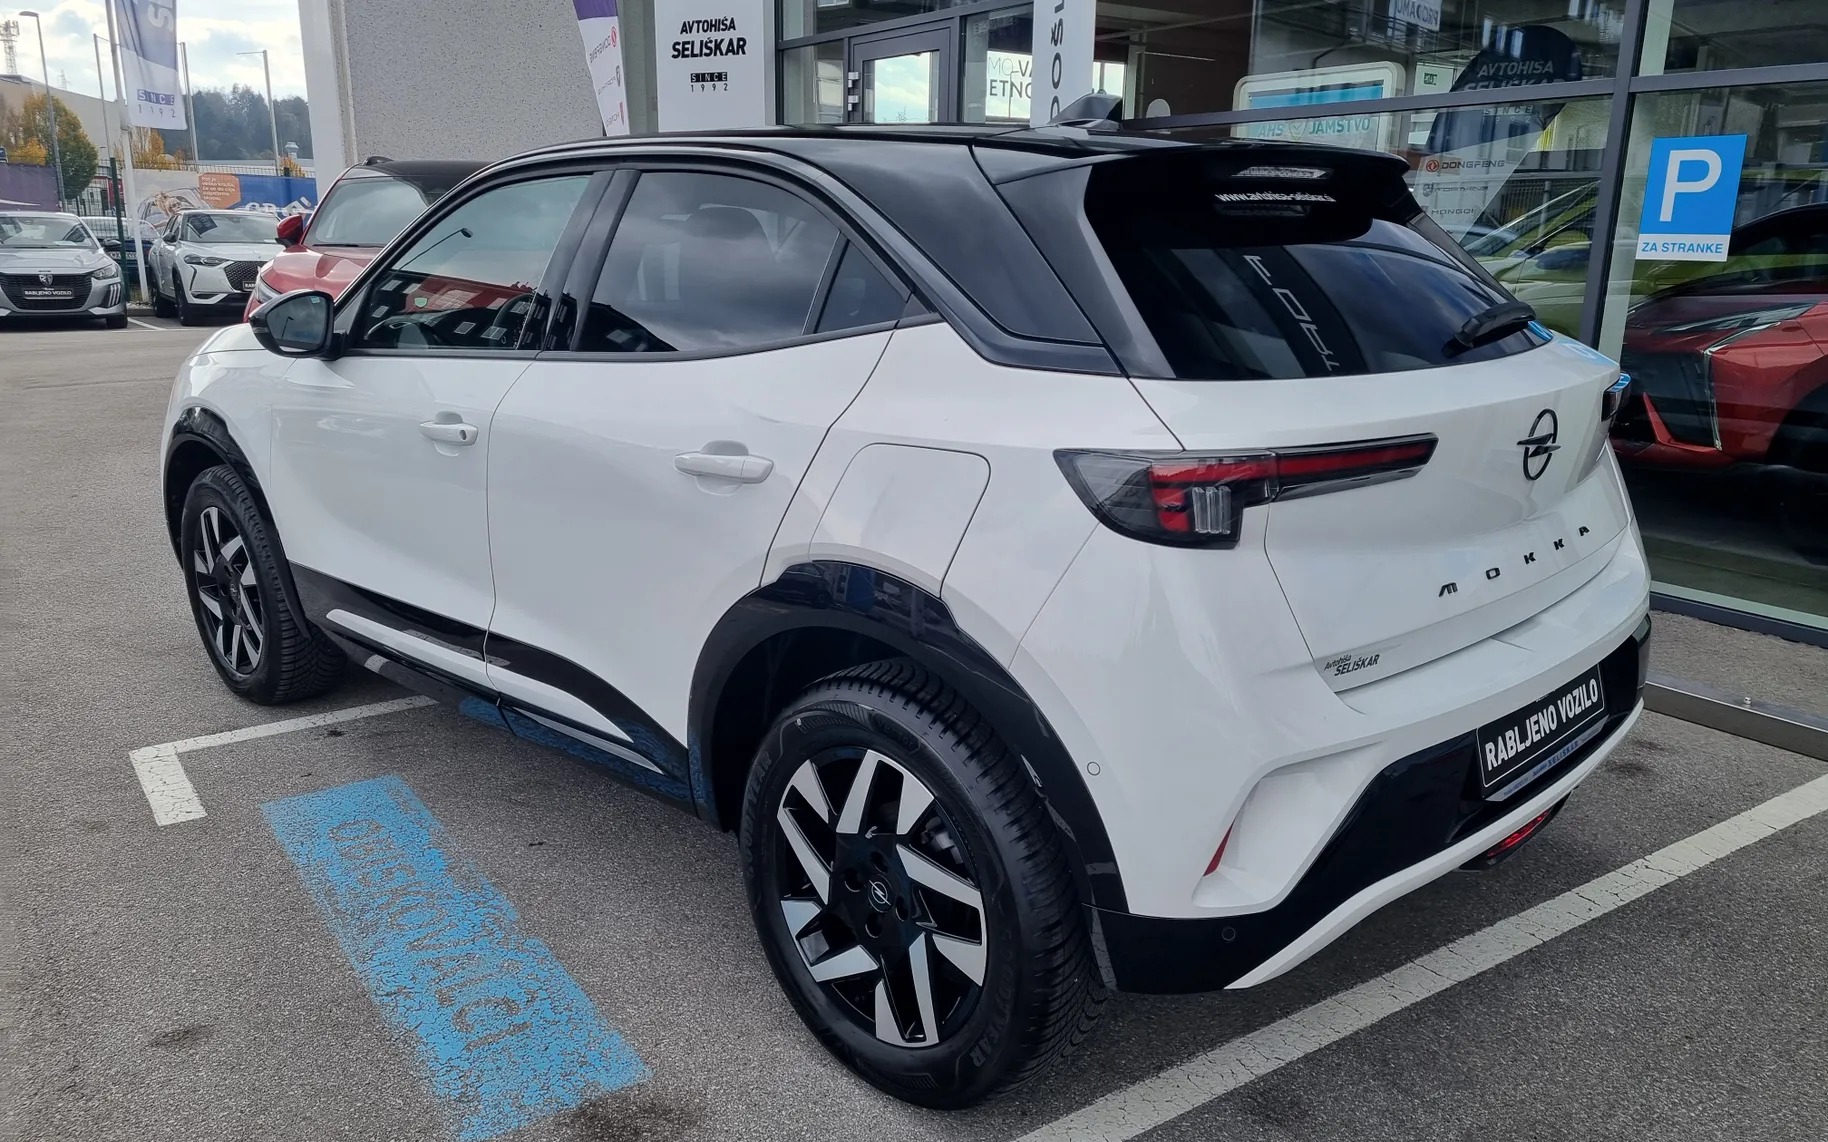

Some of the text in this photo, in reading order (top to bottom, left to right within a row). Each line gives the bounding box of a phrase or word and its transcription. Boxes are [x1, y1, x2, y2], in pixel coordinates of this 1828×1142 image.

[680, 16, 736, 35] AVTOHIŠA
[671, 37, 747, 59] SELIŠKAR
[691, 73, 727, 82] SINCE
[691, 83, 728, 92] 1992
[1258, 118, 1371, 137] AHS JAMSTVO
[1441, 160, 1505, 169] DONGFENG
[1660, 149, 1722, 222] P
[1641, 242, 1723, 253] ZA STRANKE
[1438, 526, 1590, 598] MOKKA
[1334, 654, 1380, 677] SELIŠKAR
[1485, 678, 1599, 771] RABLJENO VOZILO
